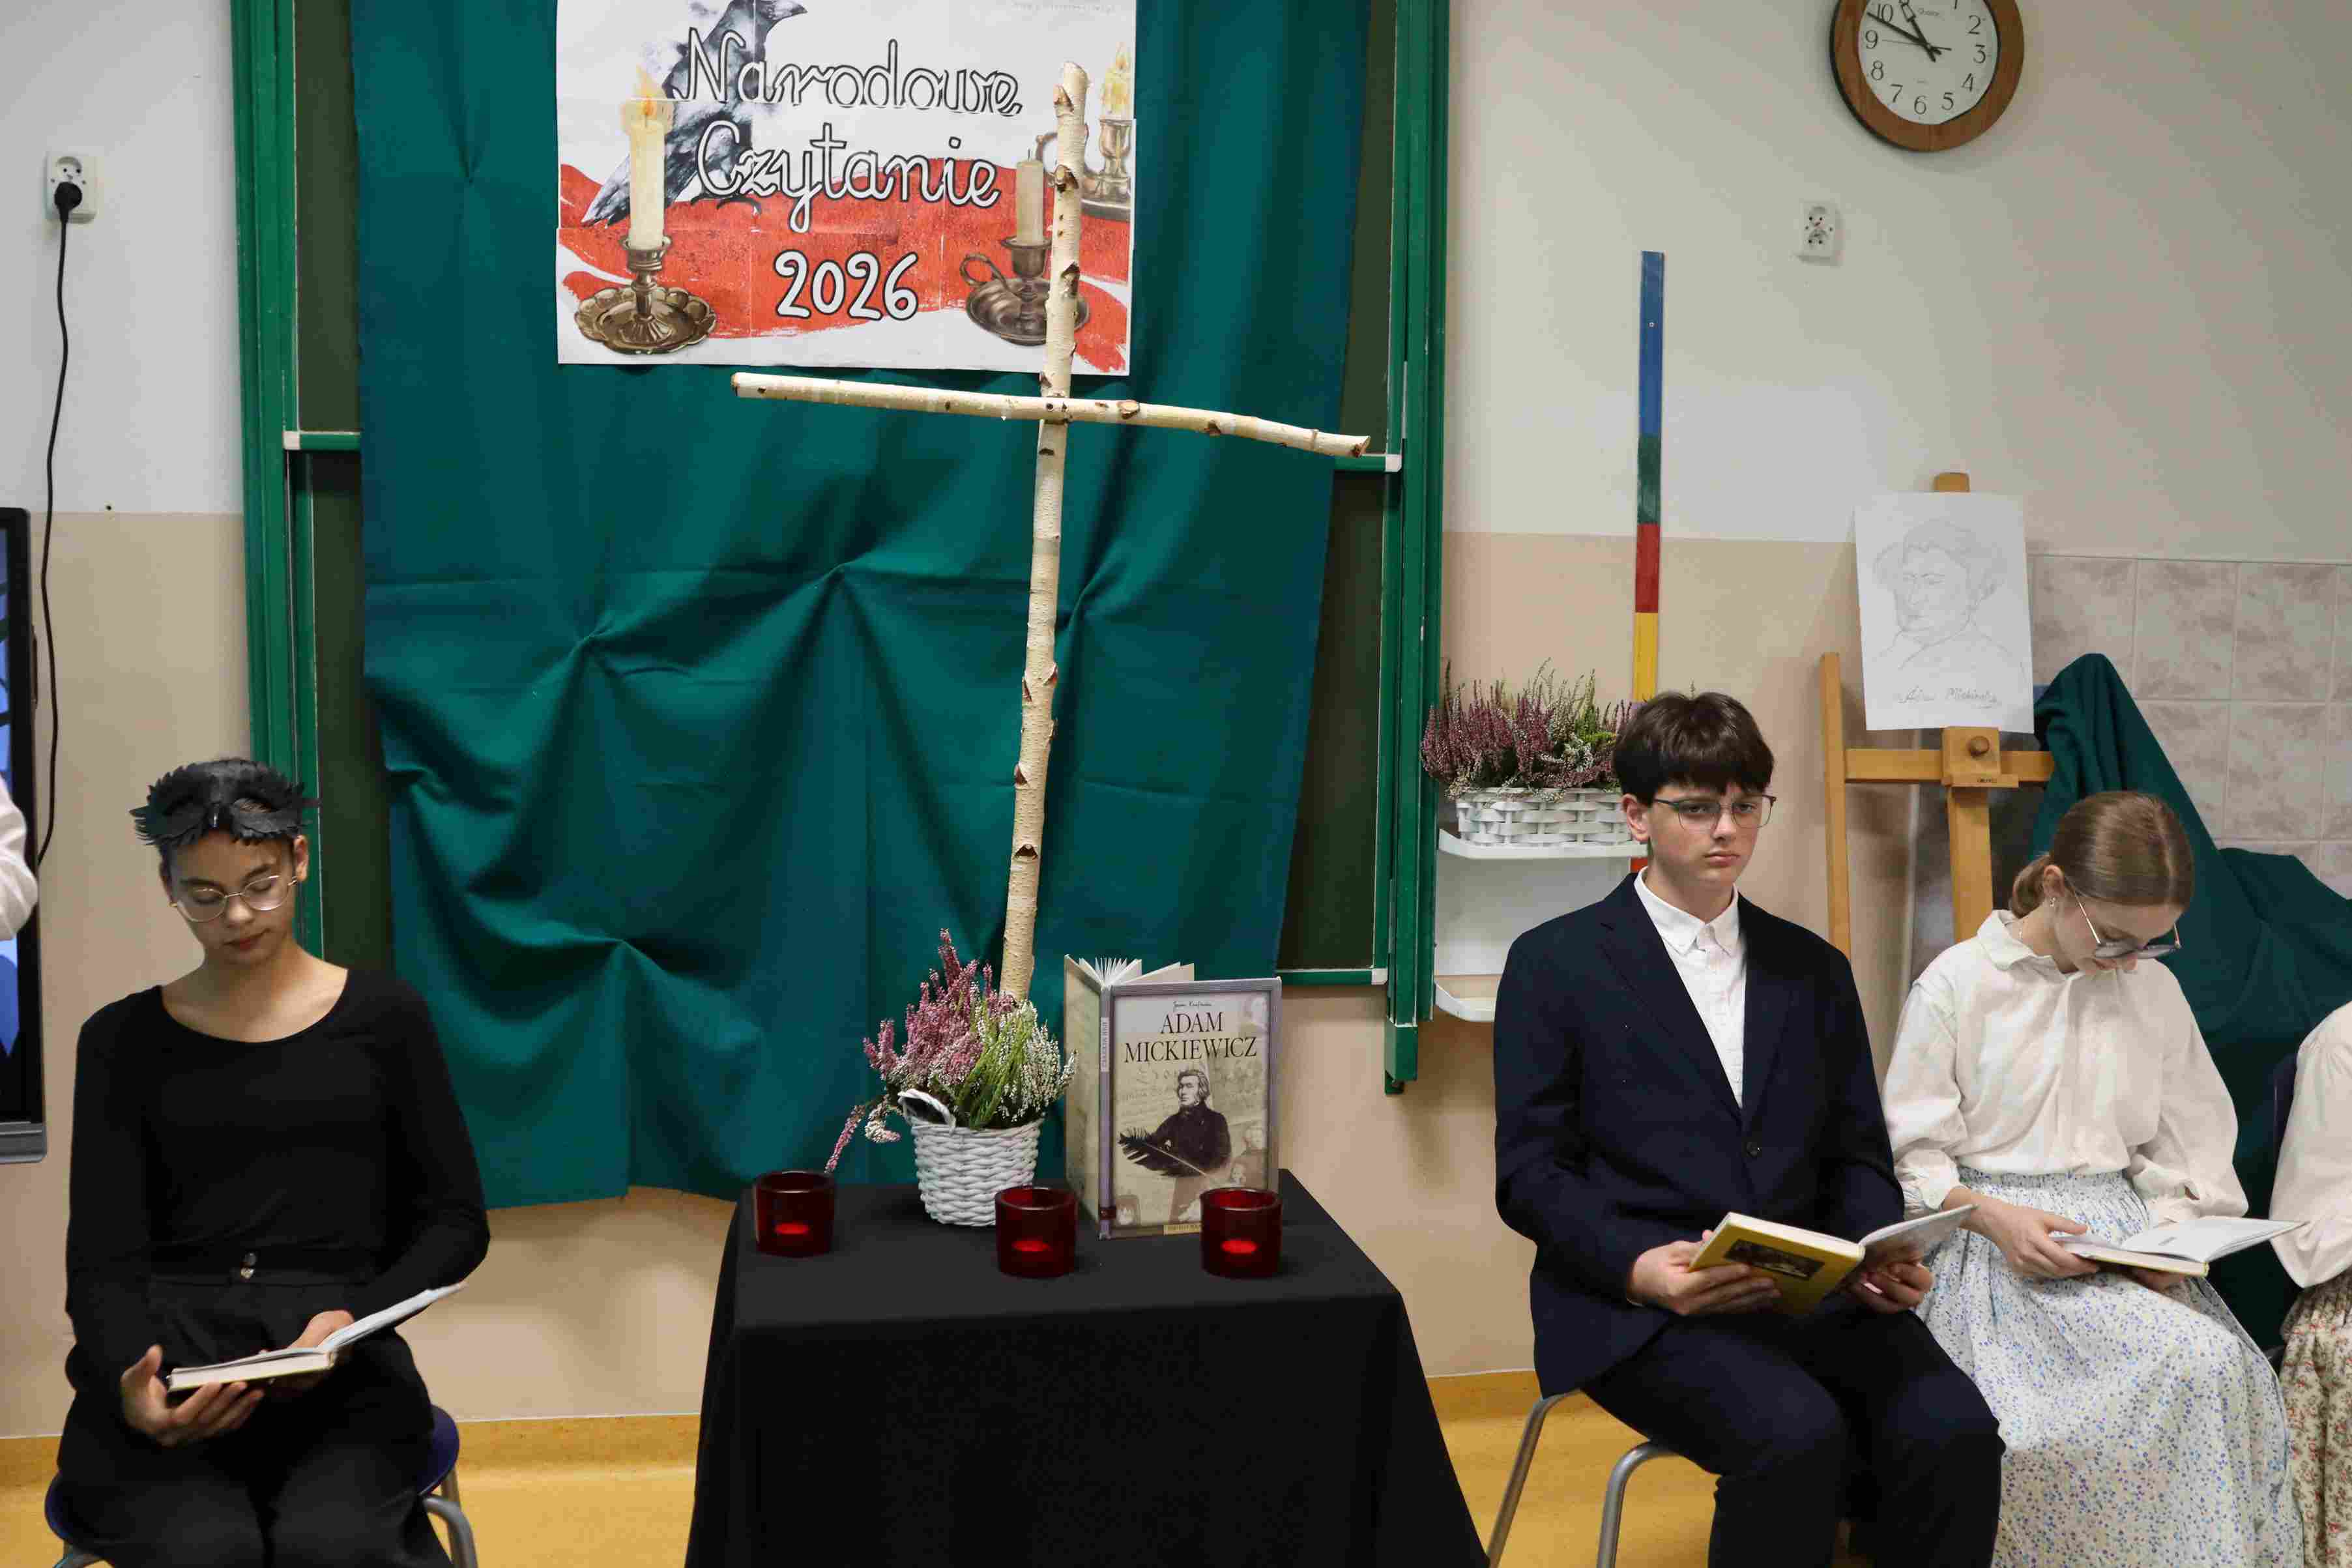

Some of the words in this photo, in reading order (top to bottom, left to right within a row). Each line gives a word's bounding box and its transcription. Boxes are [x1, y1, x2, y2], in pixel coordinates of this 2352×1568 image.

[1877, 4, 1893, 23] 10
[1968, 15, 1982, 35] 2
[1865, 30, 1878, 49] 9
[1973, 44, 1986, 64] 3
[672, 27, 1023, 117] Narodowe
[1871, 61, 1883, 80] 8
[1962, 73, 1973, 91] 4
[1891, 83, 1903, 102] 7
[1941, 92, 1954, 110] 5
[1914, 96, 1927, 115] 6
[697, 120, 1002, 234] Czytanie
[774, 249, 919, 321] 2026
[1159, 1011, 1225, 1034] ADAM
[1124, 1036, 1257, 1063] MICKIEWICZ
